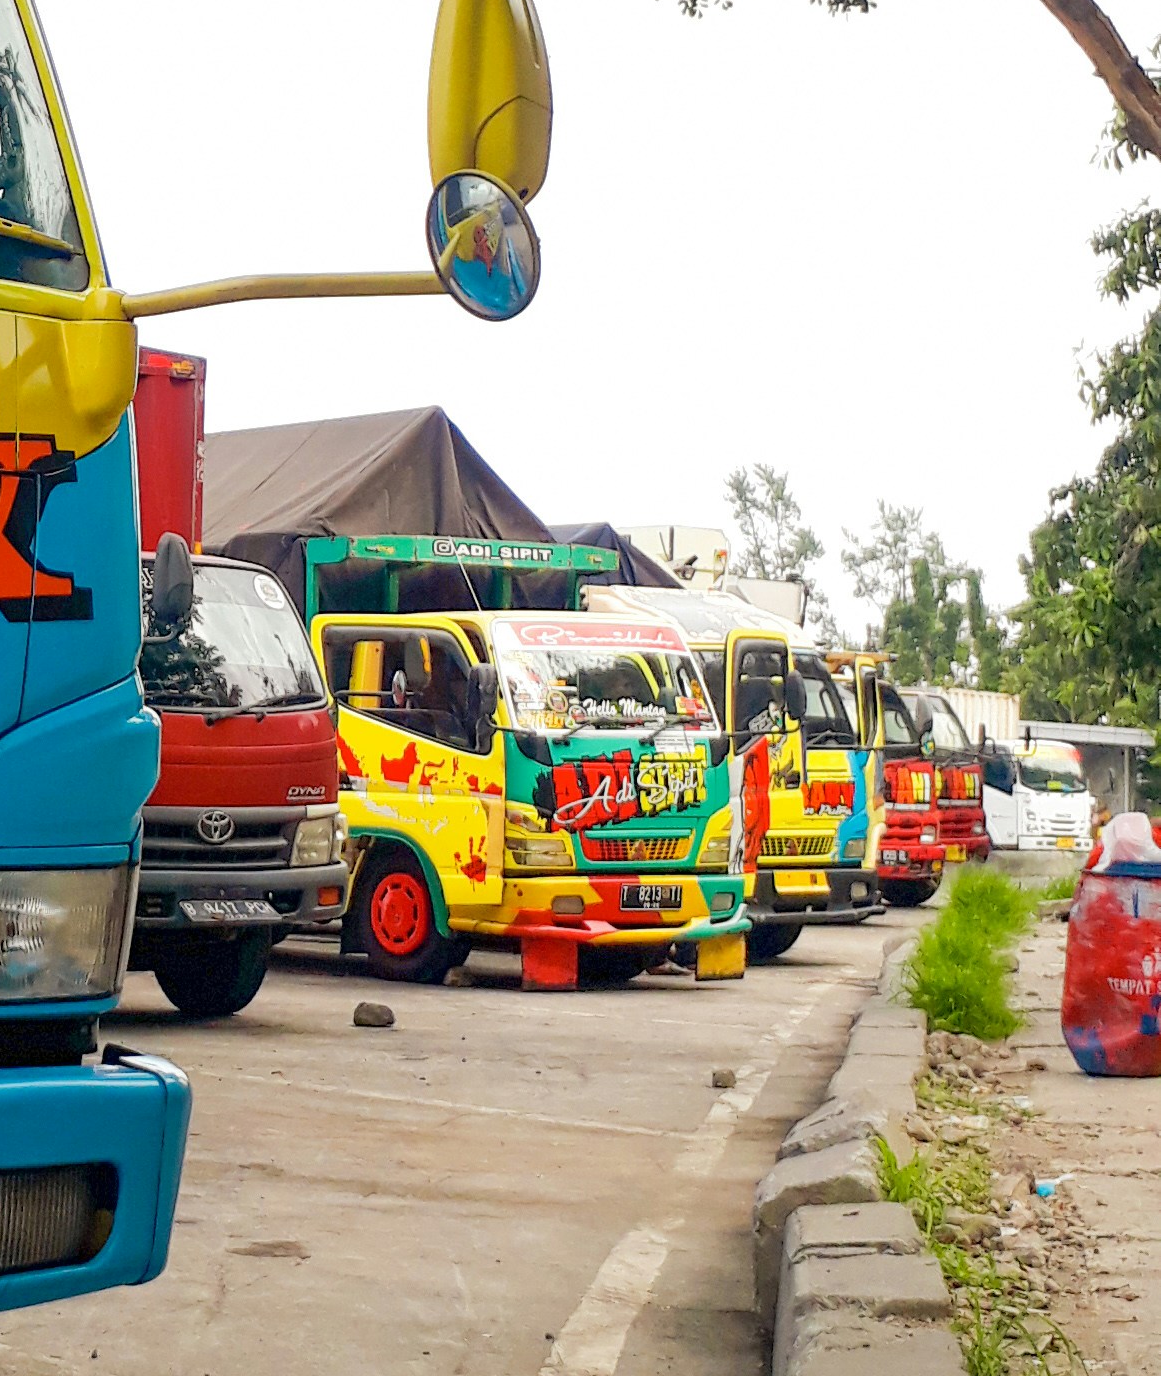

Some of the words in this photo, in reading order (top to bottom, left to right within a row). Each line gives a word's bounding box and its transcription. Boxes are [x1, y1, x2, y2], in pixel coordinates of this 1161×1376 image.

[582, 698, 618, 716] Hello
[288, 786, 326, 795] DYNA
[639, 885, 662, 902] 8213
[1107, 976, 1153, 996] TEMPAT
